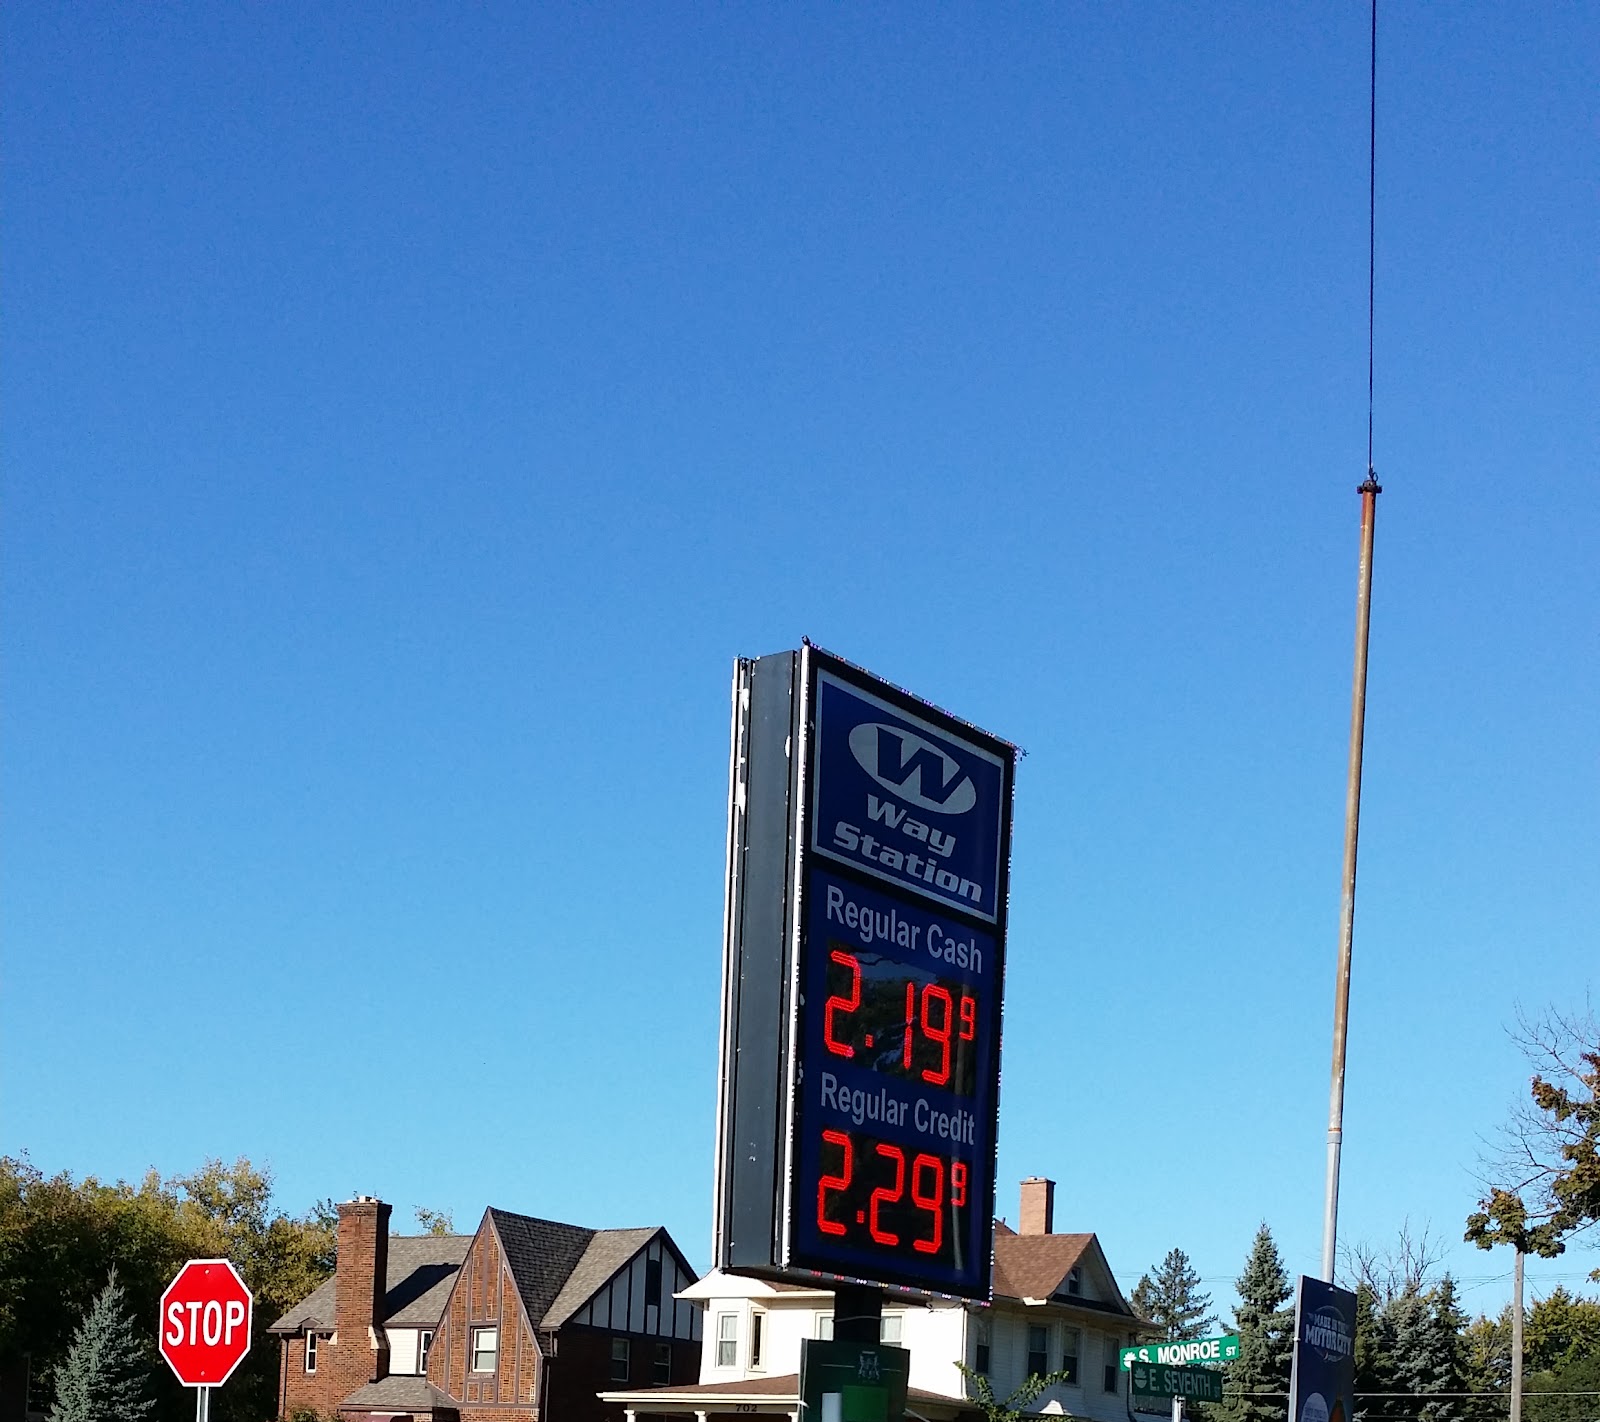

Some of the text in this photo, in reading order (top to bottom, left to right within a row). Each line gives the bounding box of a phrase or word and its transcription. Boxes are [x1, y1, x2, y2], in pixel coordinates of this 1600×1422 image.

[866, 792, 957, 858] Way
[833, 820, 983, 903] Station
[826, 883, 983, 974] Regular Cash
[820, 1071, 976, 1146] Regular Credit
[165, 1299, 246, 1347] STOP
[1157, 1340, 1221, 1363] MONROE
[1225, 1345, 1237, 1356] ST
[1149, 1368, 1160, 1392] E.
[1163, 1369, 1211, 1396] SEVENTH
